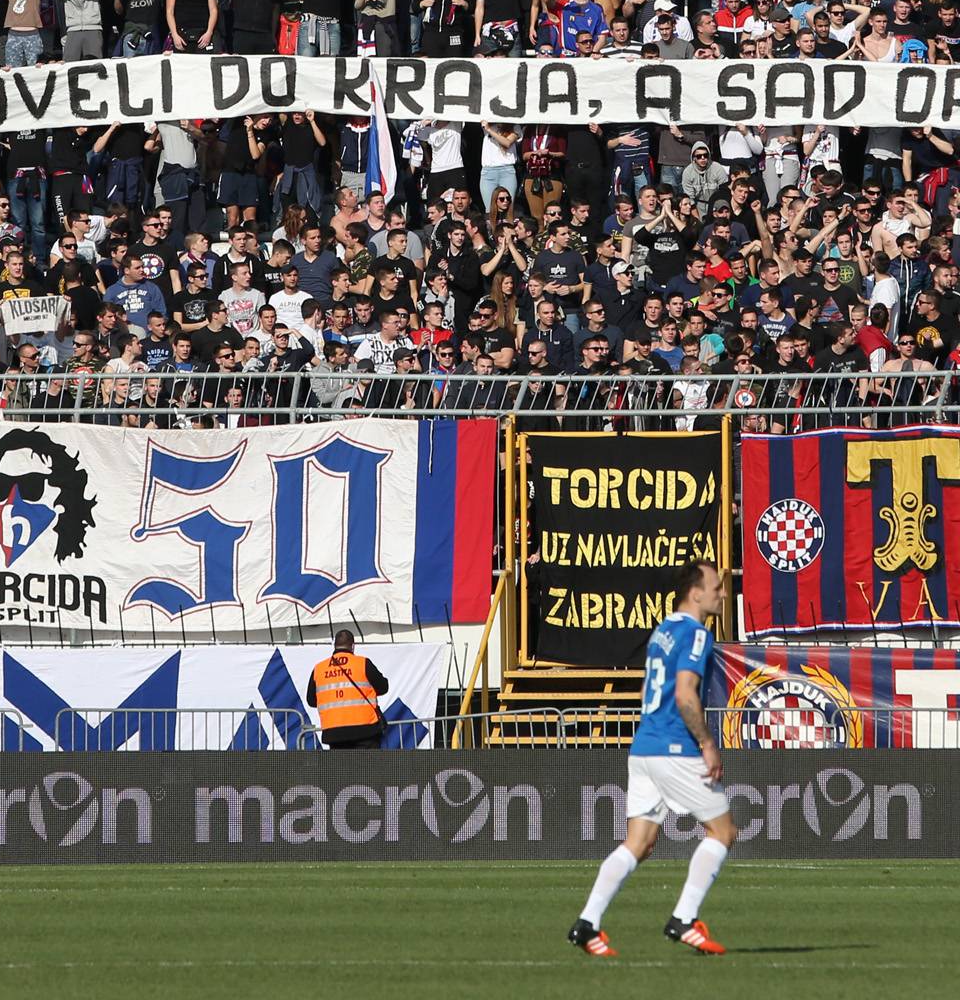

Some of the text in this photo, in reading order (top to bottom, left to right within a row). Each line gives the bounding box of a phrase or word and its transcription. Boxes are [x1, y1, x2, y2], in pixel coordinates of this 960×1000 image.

[211, 55, 297, 111] DO
[333, 56, 603, 118] KRAJA,
[635, 63, 682, 122] A
[716, 63, 866, 121] SAD
[761, 499, 819, 527] HAJDUK
[542, 530, 572, 567] UZ
[768, 553, 813, 571] SPLIT
[750, 680, 833, 711] HAJDUK
